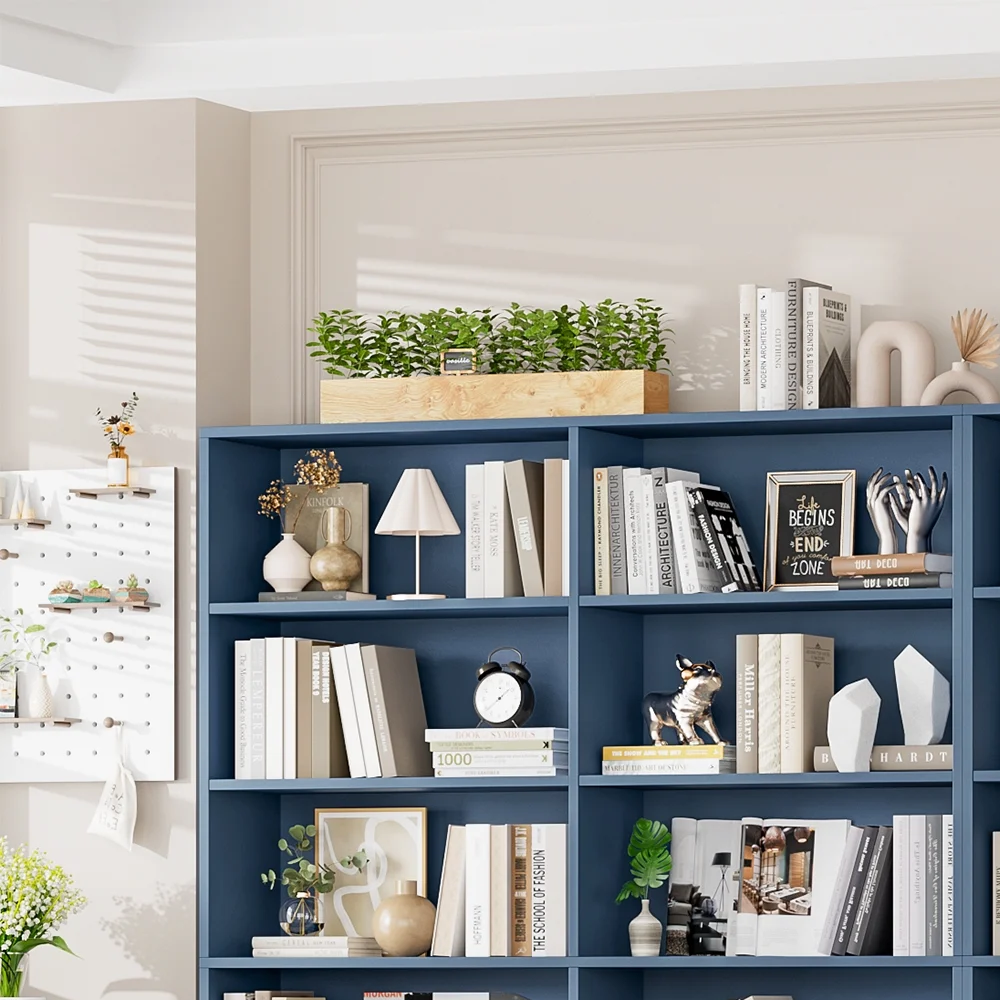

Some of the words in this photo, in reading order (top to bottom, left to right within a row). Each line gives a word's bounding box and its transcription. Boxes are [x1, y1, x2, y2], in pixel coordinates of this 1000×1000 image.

[788, 280, 796, 359] FURNITURE
[806, 311, 814, 353] BLUEPRINTS
[788, 362, 796, 411] DESIGN
[806, 361, 814, 395] BUILDINGS
[306, 497, 344, 508] KINFOLK
[789, 508, 836, 527] BEGINS
[610, 473, 622, 578] INNENARCHITEKTUR
[656, 502, 672, 588] ARCHITECTURE
[697, 515, 714, 543] FASHION
[709, 544, 723, 570] DESIGN
[794, 536, 824, 553] END
[790, 561, 825, 576] ZONE
[312, 651, 320, 668] YEAR
[312, 670, 320, 689] BOOK
[744, 664, 754, 706] Miller
[744, 709, 754, 753] Harris
[438, 754, 472, 766] 1000
[533, 849, 546, 886] FASHION
[533, 888, 546, 898] OF
[533, 900, 546, 931] SCHOOL
[533, 932, 546, 952] THE
